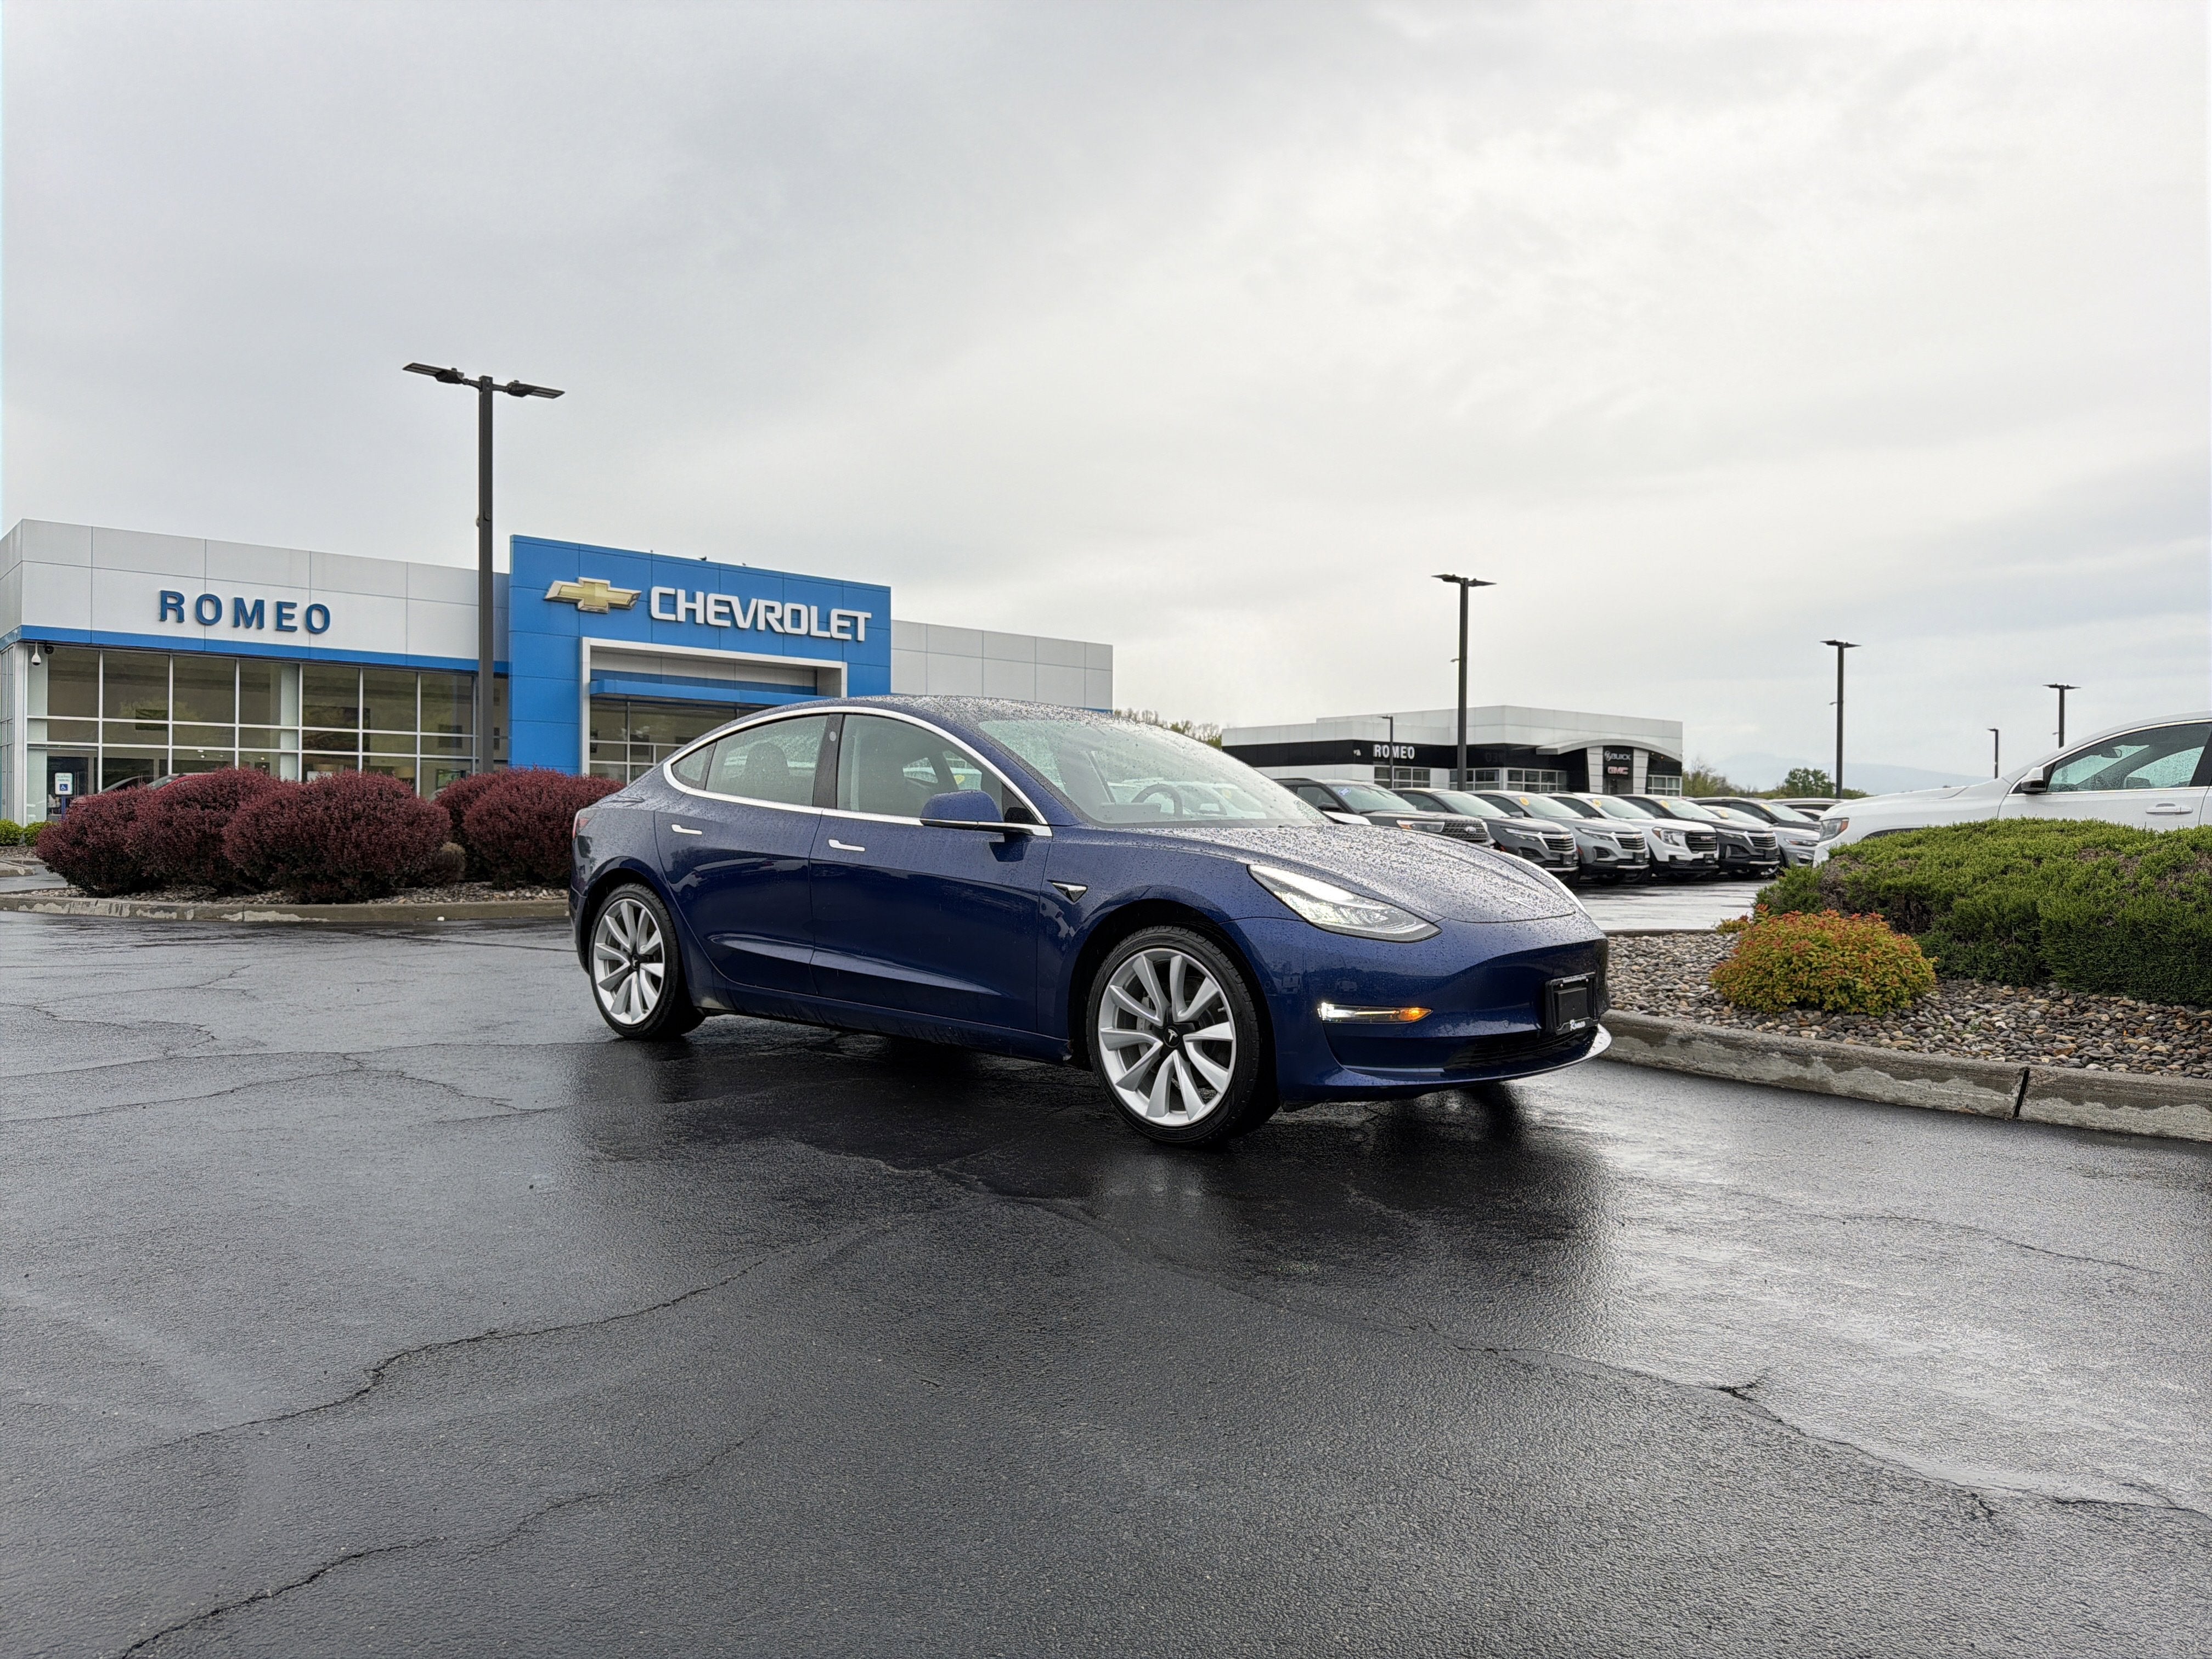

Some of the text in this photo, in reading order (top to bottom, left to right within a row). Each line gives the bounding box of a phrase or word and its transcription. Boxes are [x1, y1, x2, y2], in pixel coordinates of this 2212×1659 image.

[159, 590, 330, 634] ROMEO
[651, 586, 872, 641] CHEVROLET
[1374, 744, 1415, 759] ROMEO
[1611, 753, 1631, 761] BUICK
[1607, 766, 1628, 775] GMC
